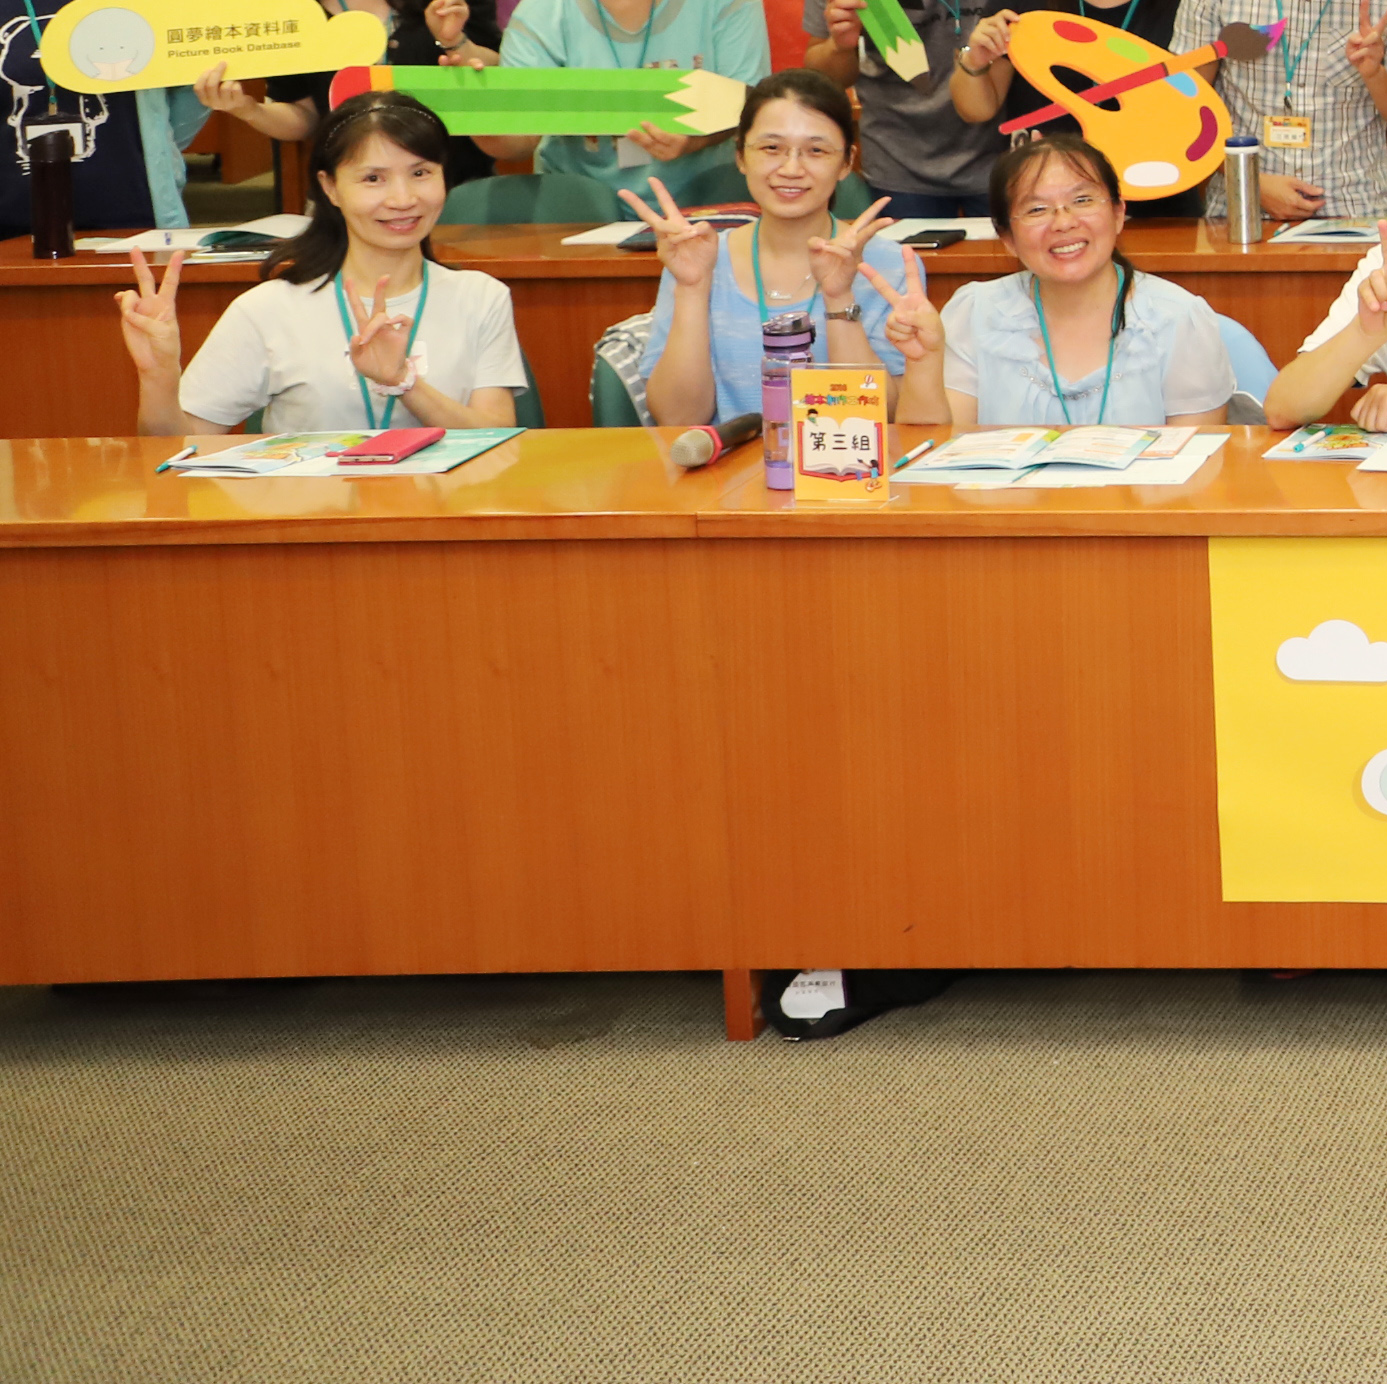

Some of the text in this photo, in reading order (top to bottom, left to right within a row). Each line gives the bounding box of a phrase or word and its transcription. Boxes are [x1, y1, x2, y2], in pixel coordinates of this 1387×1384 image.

[167, 19, 299, 44] 圓夢繪本資料庫
[167, 40, 301, 58] Picture Book Database
[809, 431, 871, 452] 第三組
